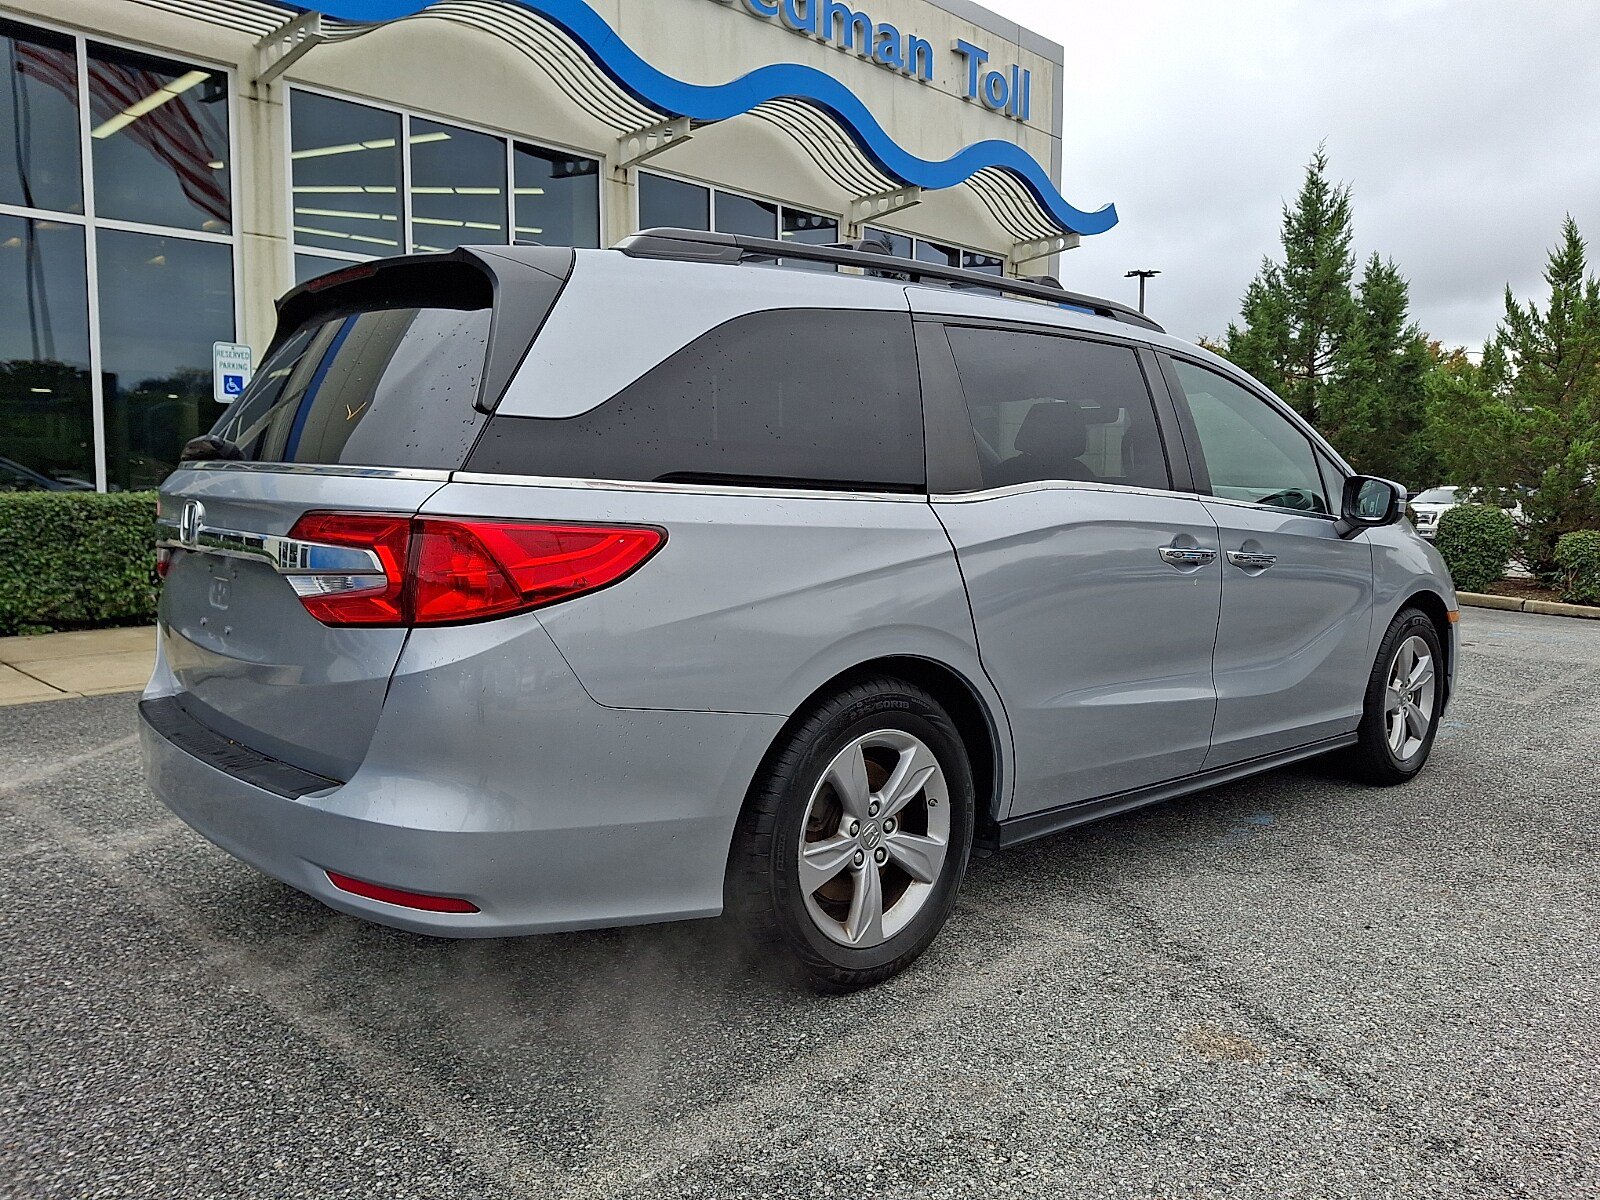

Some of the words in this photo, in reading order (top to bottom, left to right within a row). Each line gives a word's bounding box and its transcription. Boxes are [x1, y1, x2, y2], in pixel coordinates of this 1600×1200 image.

[952, 38, 1031, 121] Toll
[216, 350, 250, 360] RESERVED
[219, 361, 248, 371] PARKING
